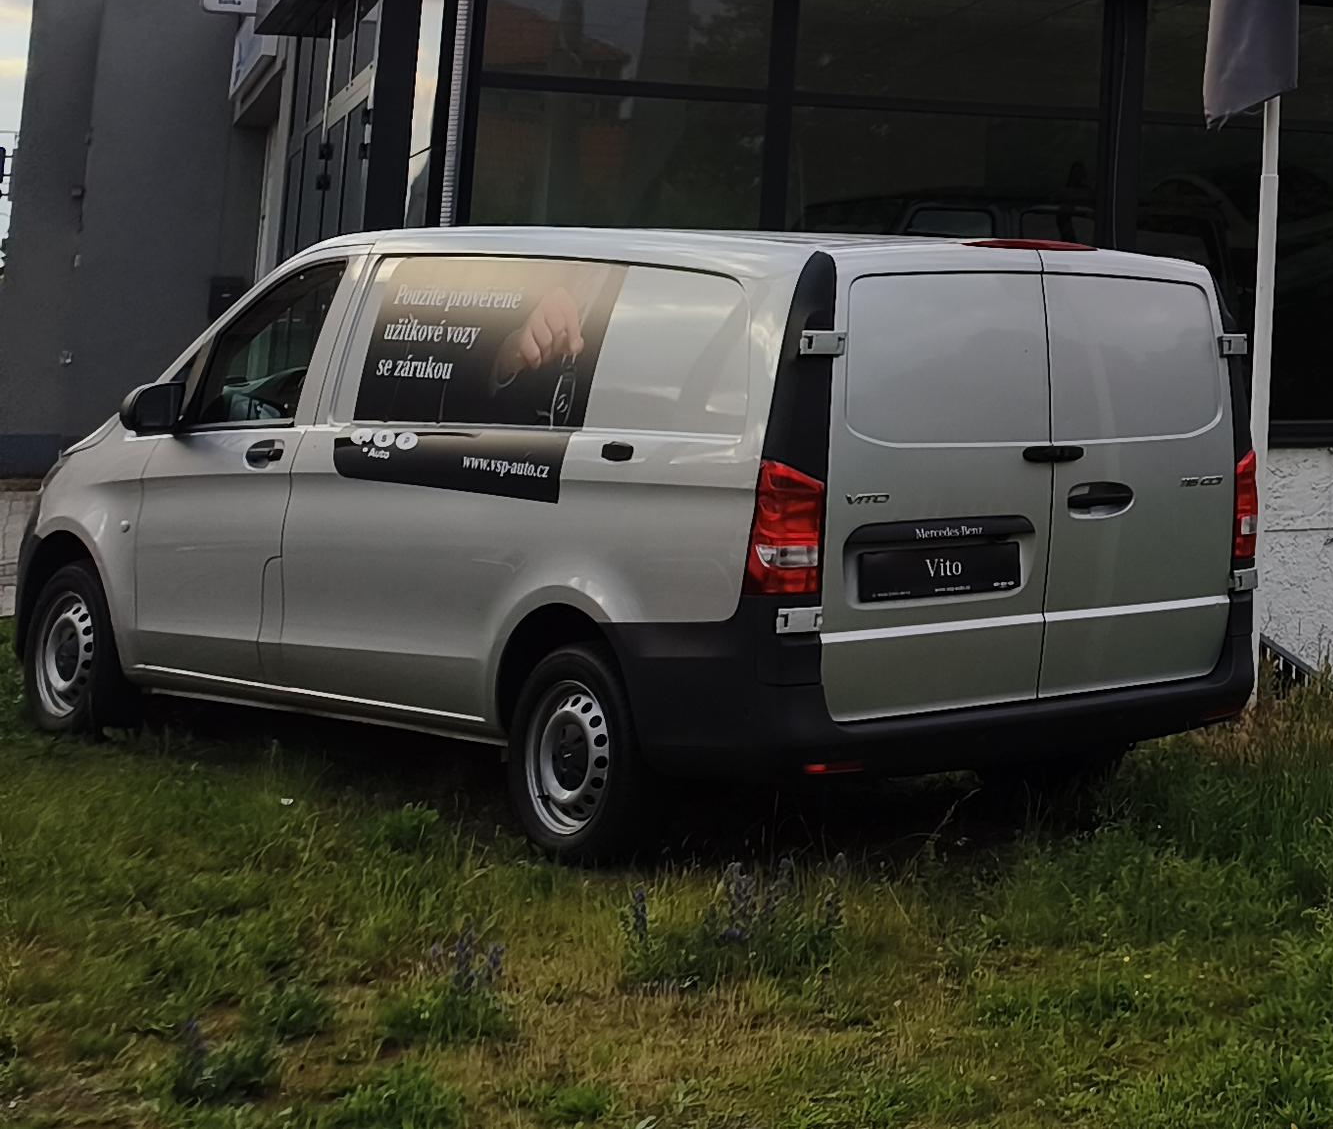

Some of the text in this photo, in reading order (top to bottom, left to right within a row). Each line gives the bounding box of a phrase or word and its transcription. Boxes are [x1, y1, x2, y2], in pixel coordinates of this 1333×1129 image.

[384, 317, 482, 350] užitkové vozy
[376, 354, 454, 380] se zárukou
[462, 455, 550, 479] www.vsp-auto.cz
[915, 525, 983, 540] Mercedes-Benz
[925, 558, 962, 578] Vito
